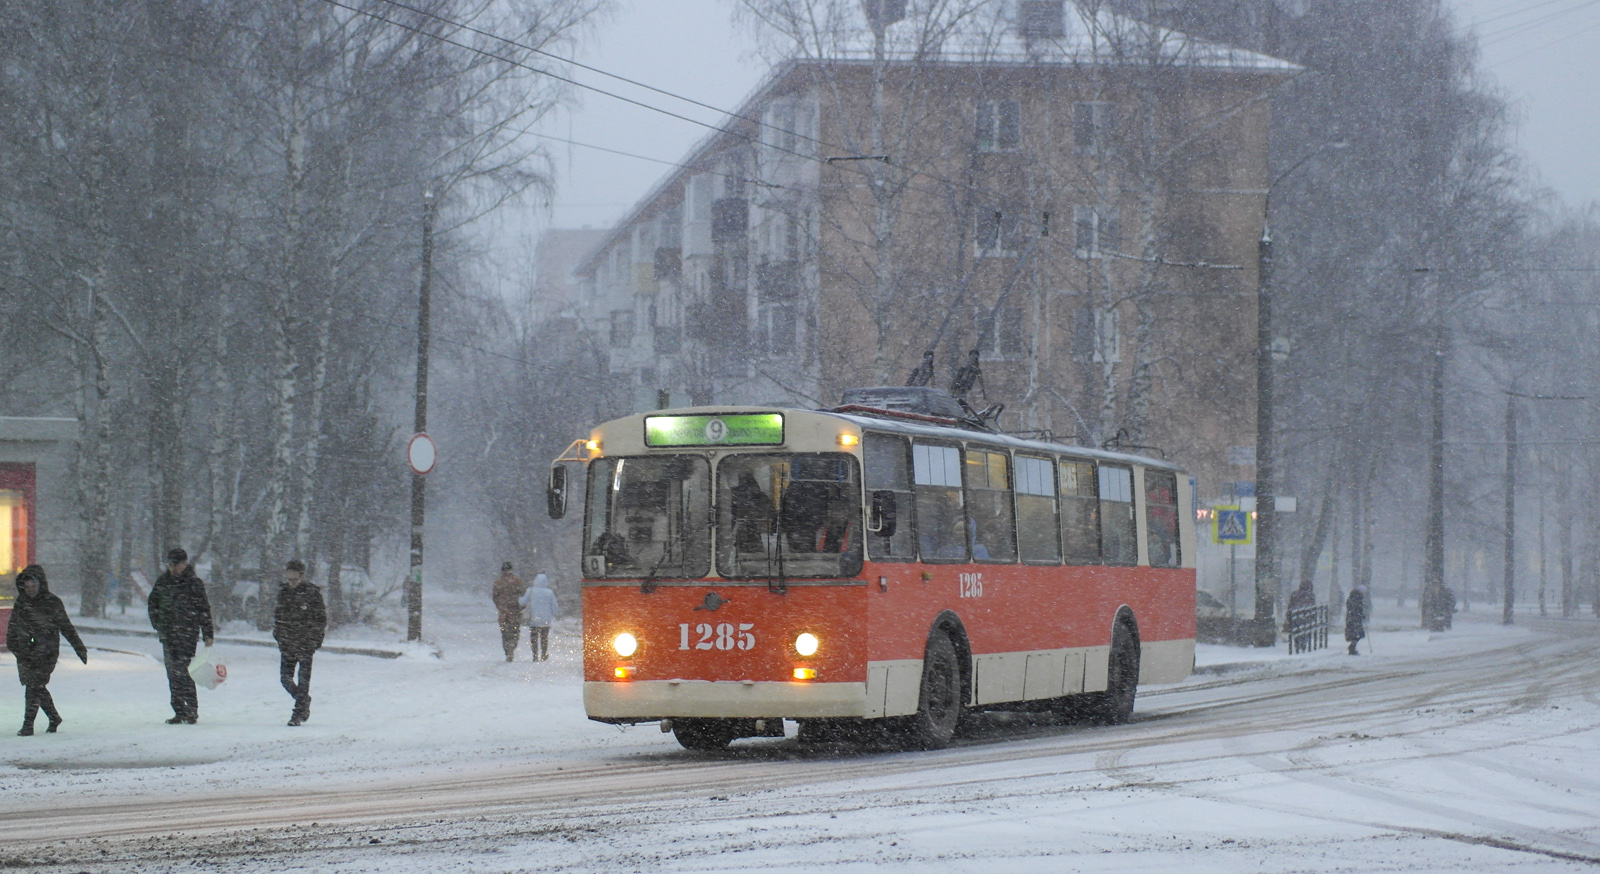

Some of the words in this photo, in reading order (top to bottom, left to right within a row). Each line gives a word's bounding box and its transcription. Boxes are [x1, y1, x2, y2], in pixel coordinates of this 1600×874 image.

[710, 420, 723, 440] 9
[959, 572, 983, 598] 1285
[678, 623, 756, 650] 1285
